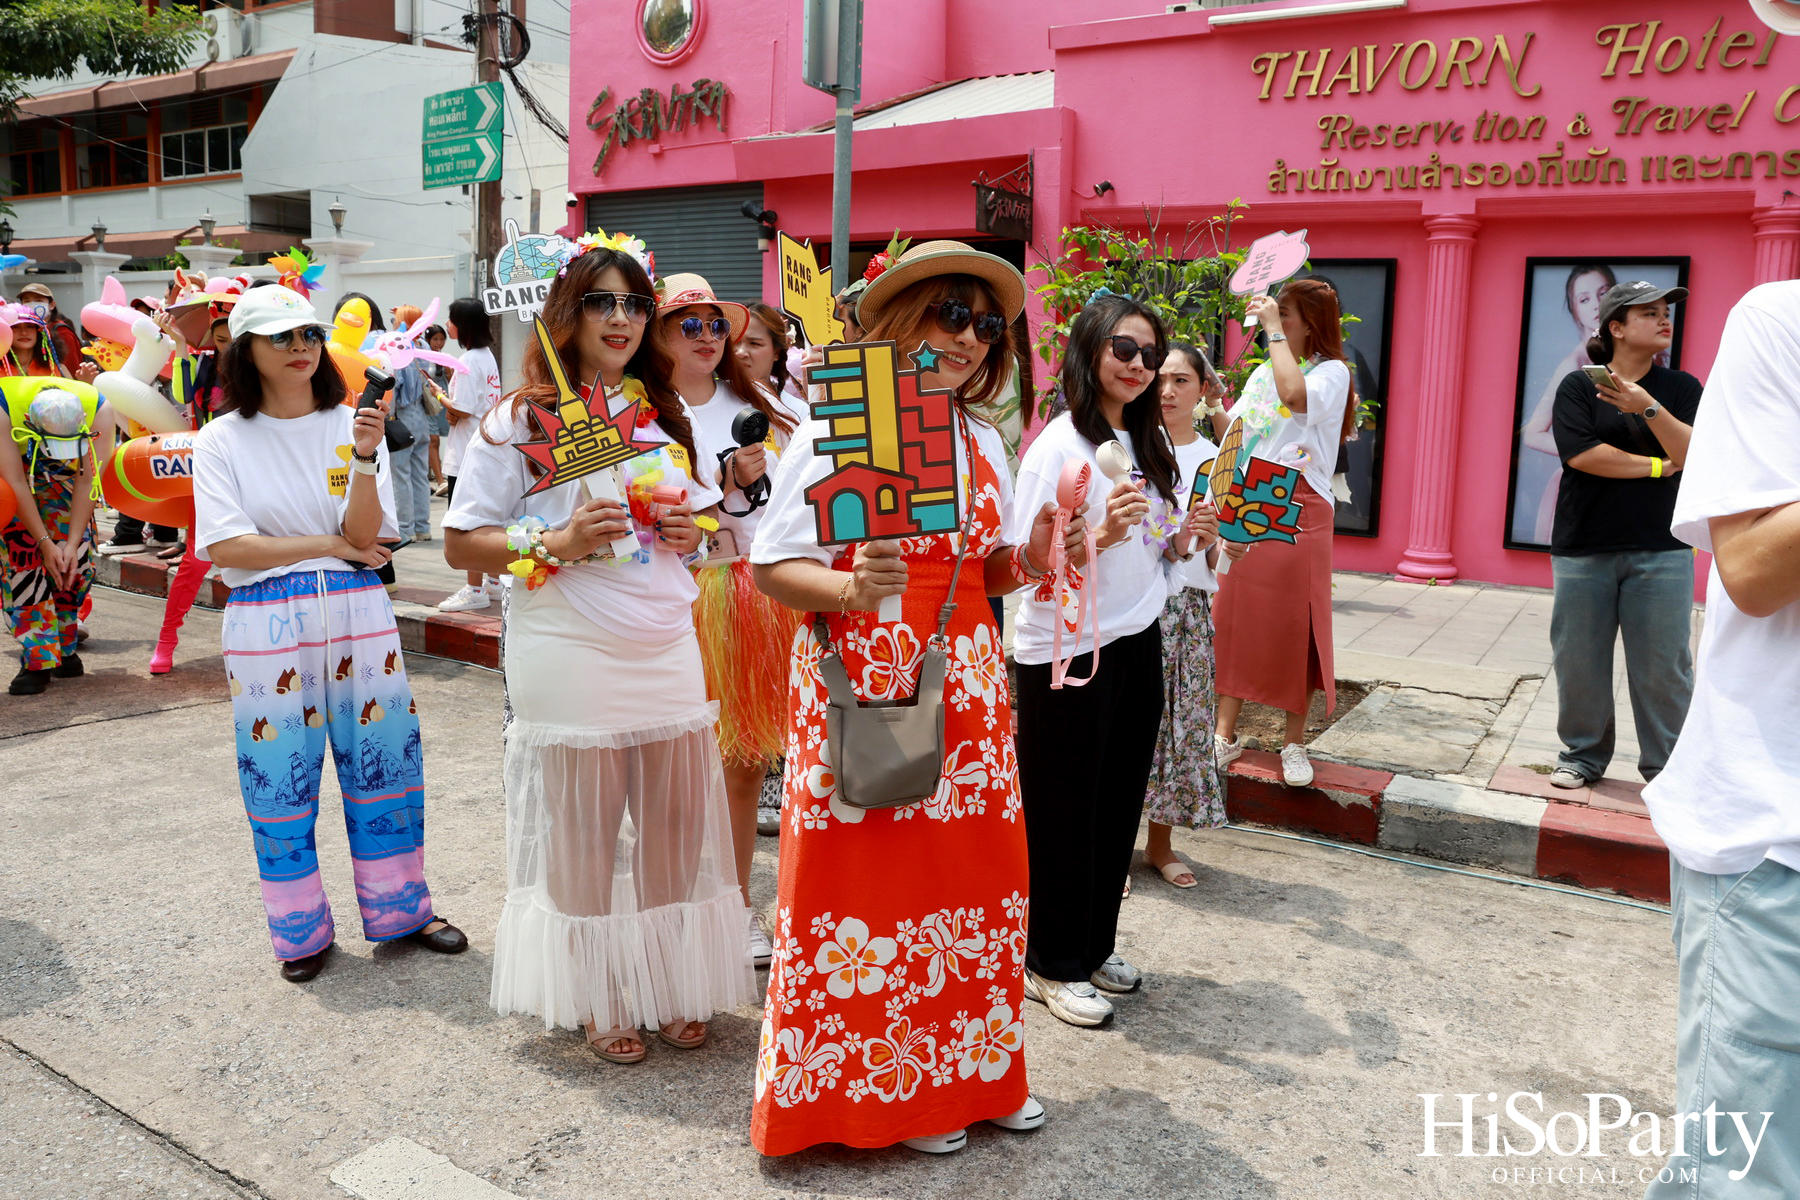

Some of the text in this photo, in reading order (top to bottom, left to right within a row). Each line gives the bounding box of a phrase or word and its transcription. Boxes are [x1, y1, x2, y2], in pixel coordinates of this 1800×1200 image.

[1251, 15, 1780, 99] THAVORN Hotel
[1317, 109, 1548, 148] Reservtion
[1566, 112, 1592, 136] &
[1611, 89, 1757, 134] Travel
[786, 254, 812, 284] RANG
[1245, 251, 1267, 285] RANG
[1258, 253, 1277, 281] NAM
[486, 284, 548, 310] RANG
[787, 273, 808, 299] NAM
